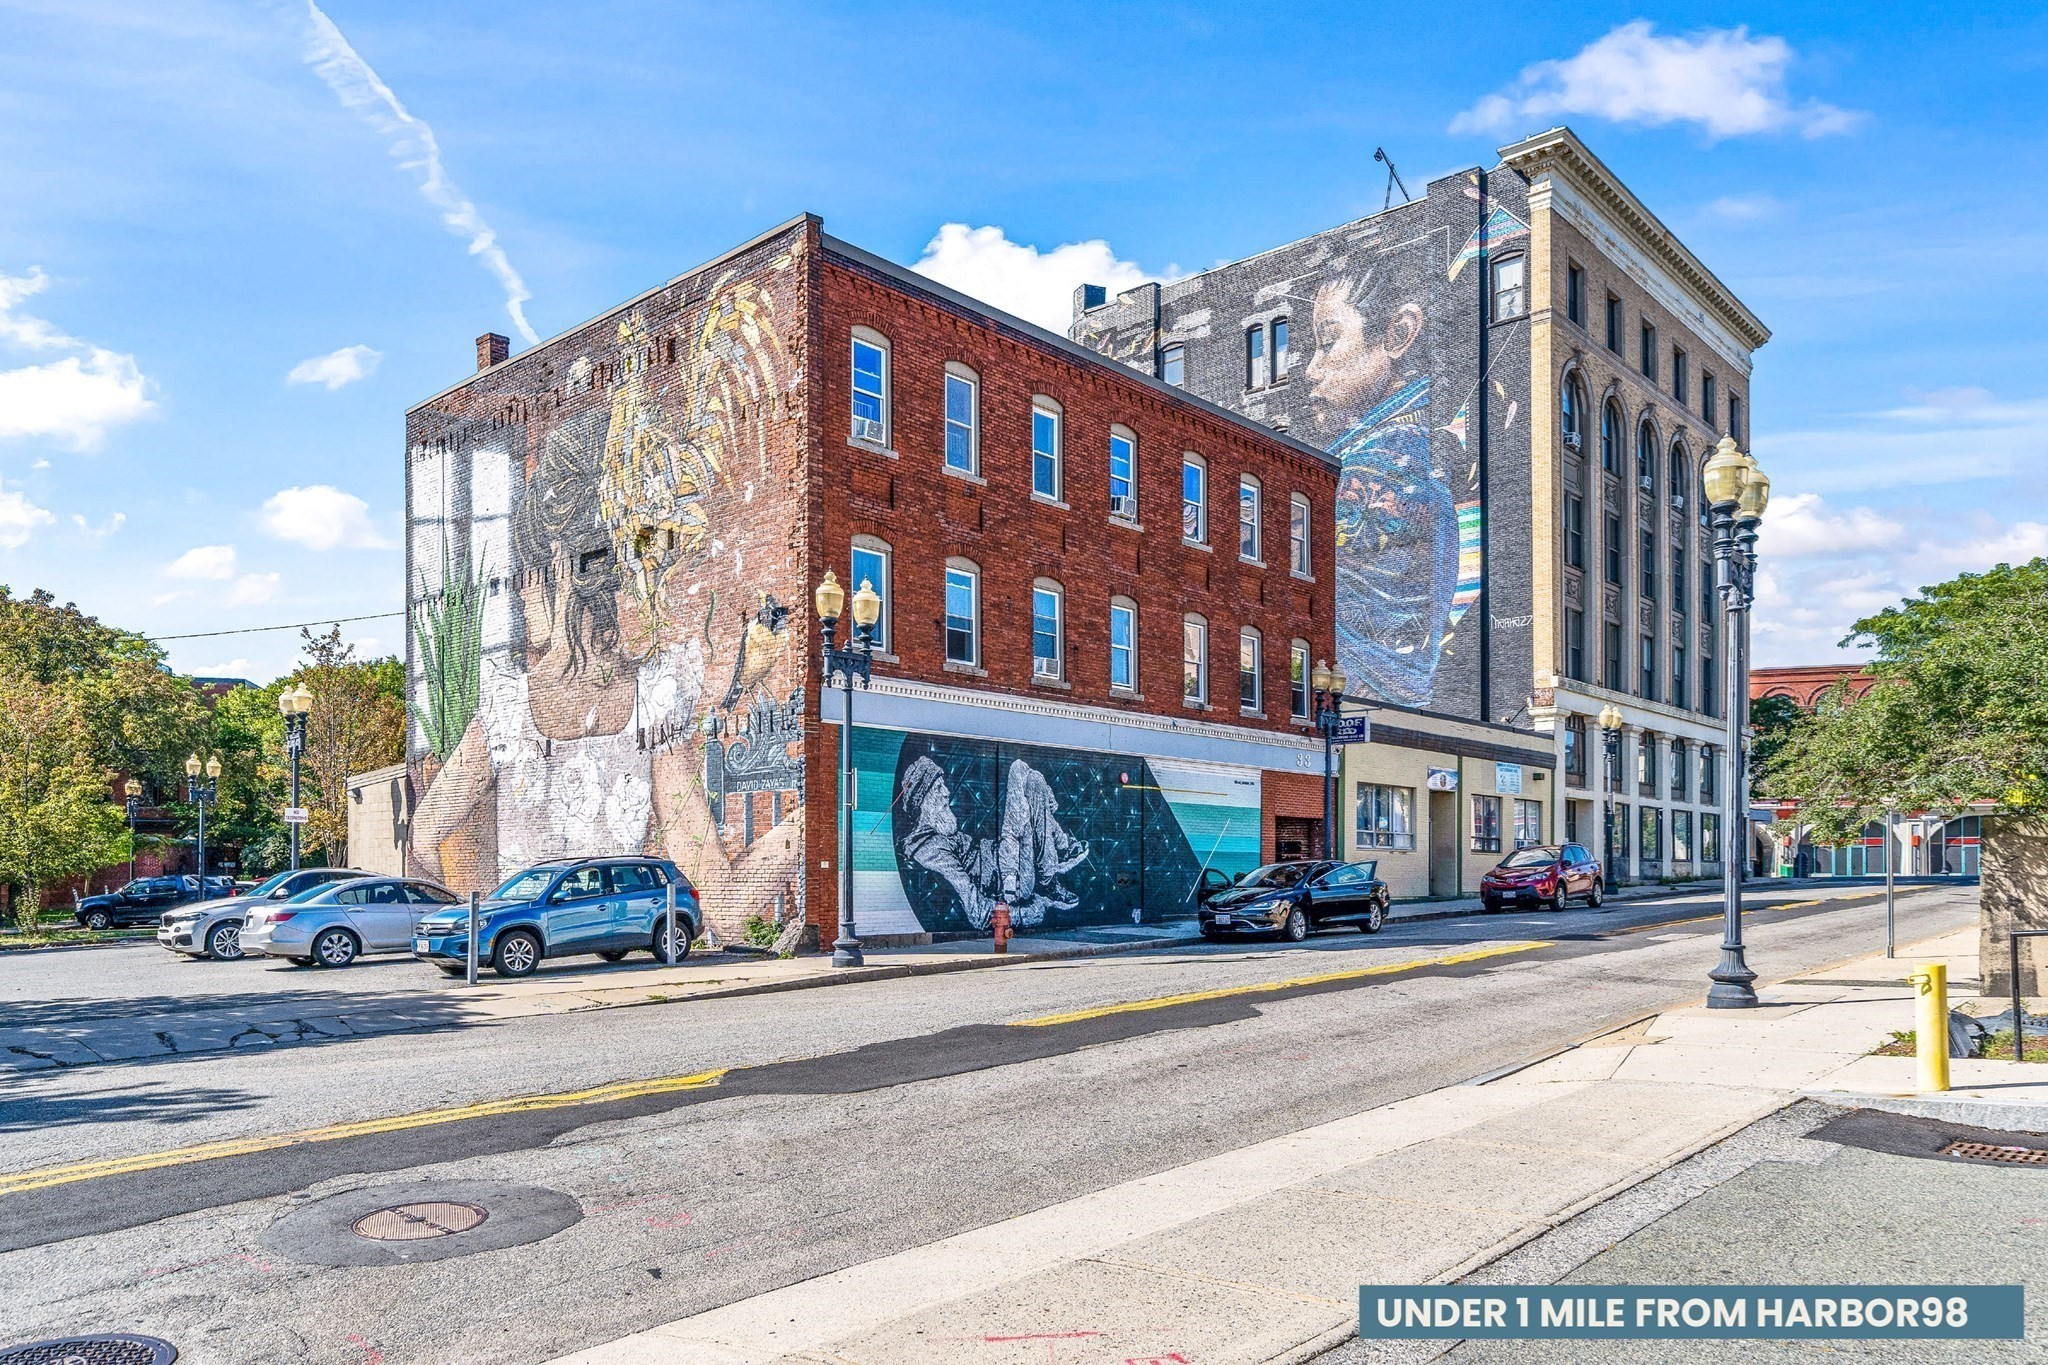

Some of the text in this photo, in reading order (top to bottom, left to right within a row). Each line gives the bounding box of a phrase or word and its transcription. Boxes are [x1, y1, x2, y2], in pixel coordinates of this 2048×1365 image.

[1296, 753, 1311, 768] 33
[736, 779, 758, 792] DAVID
[761, 778, 784, 790] ZAYAS
